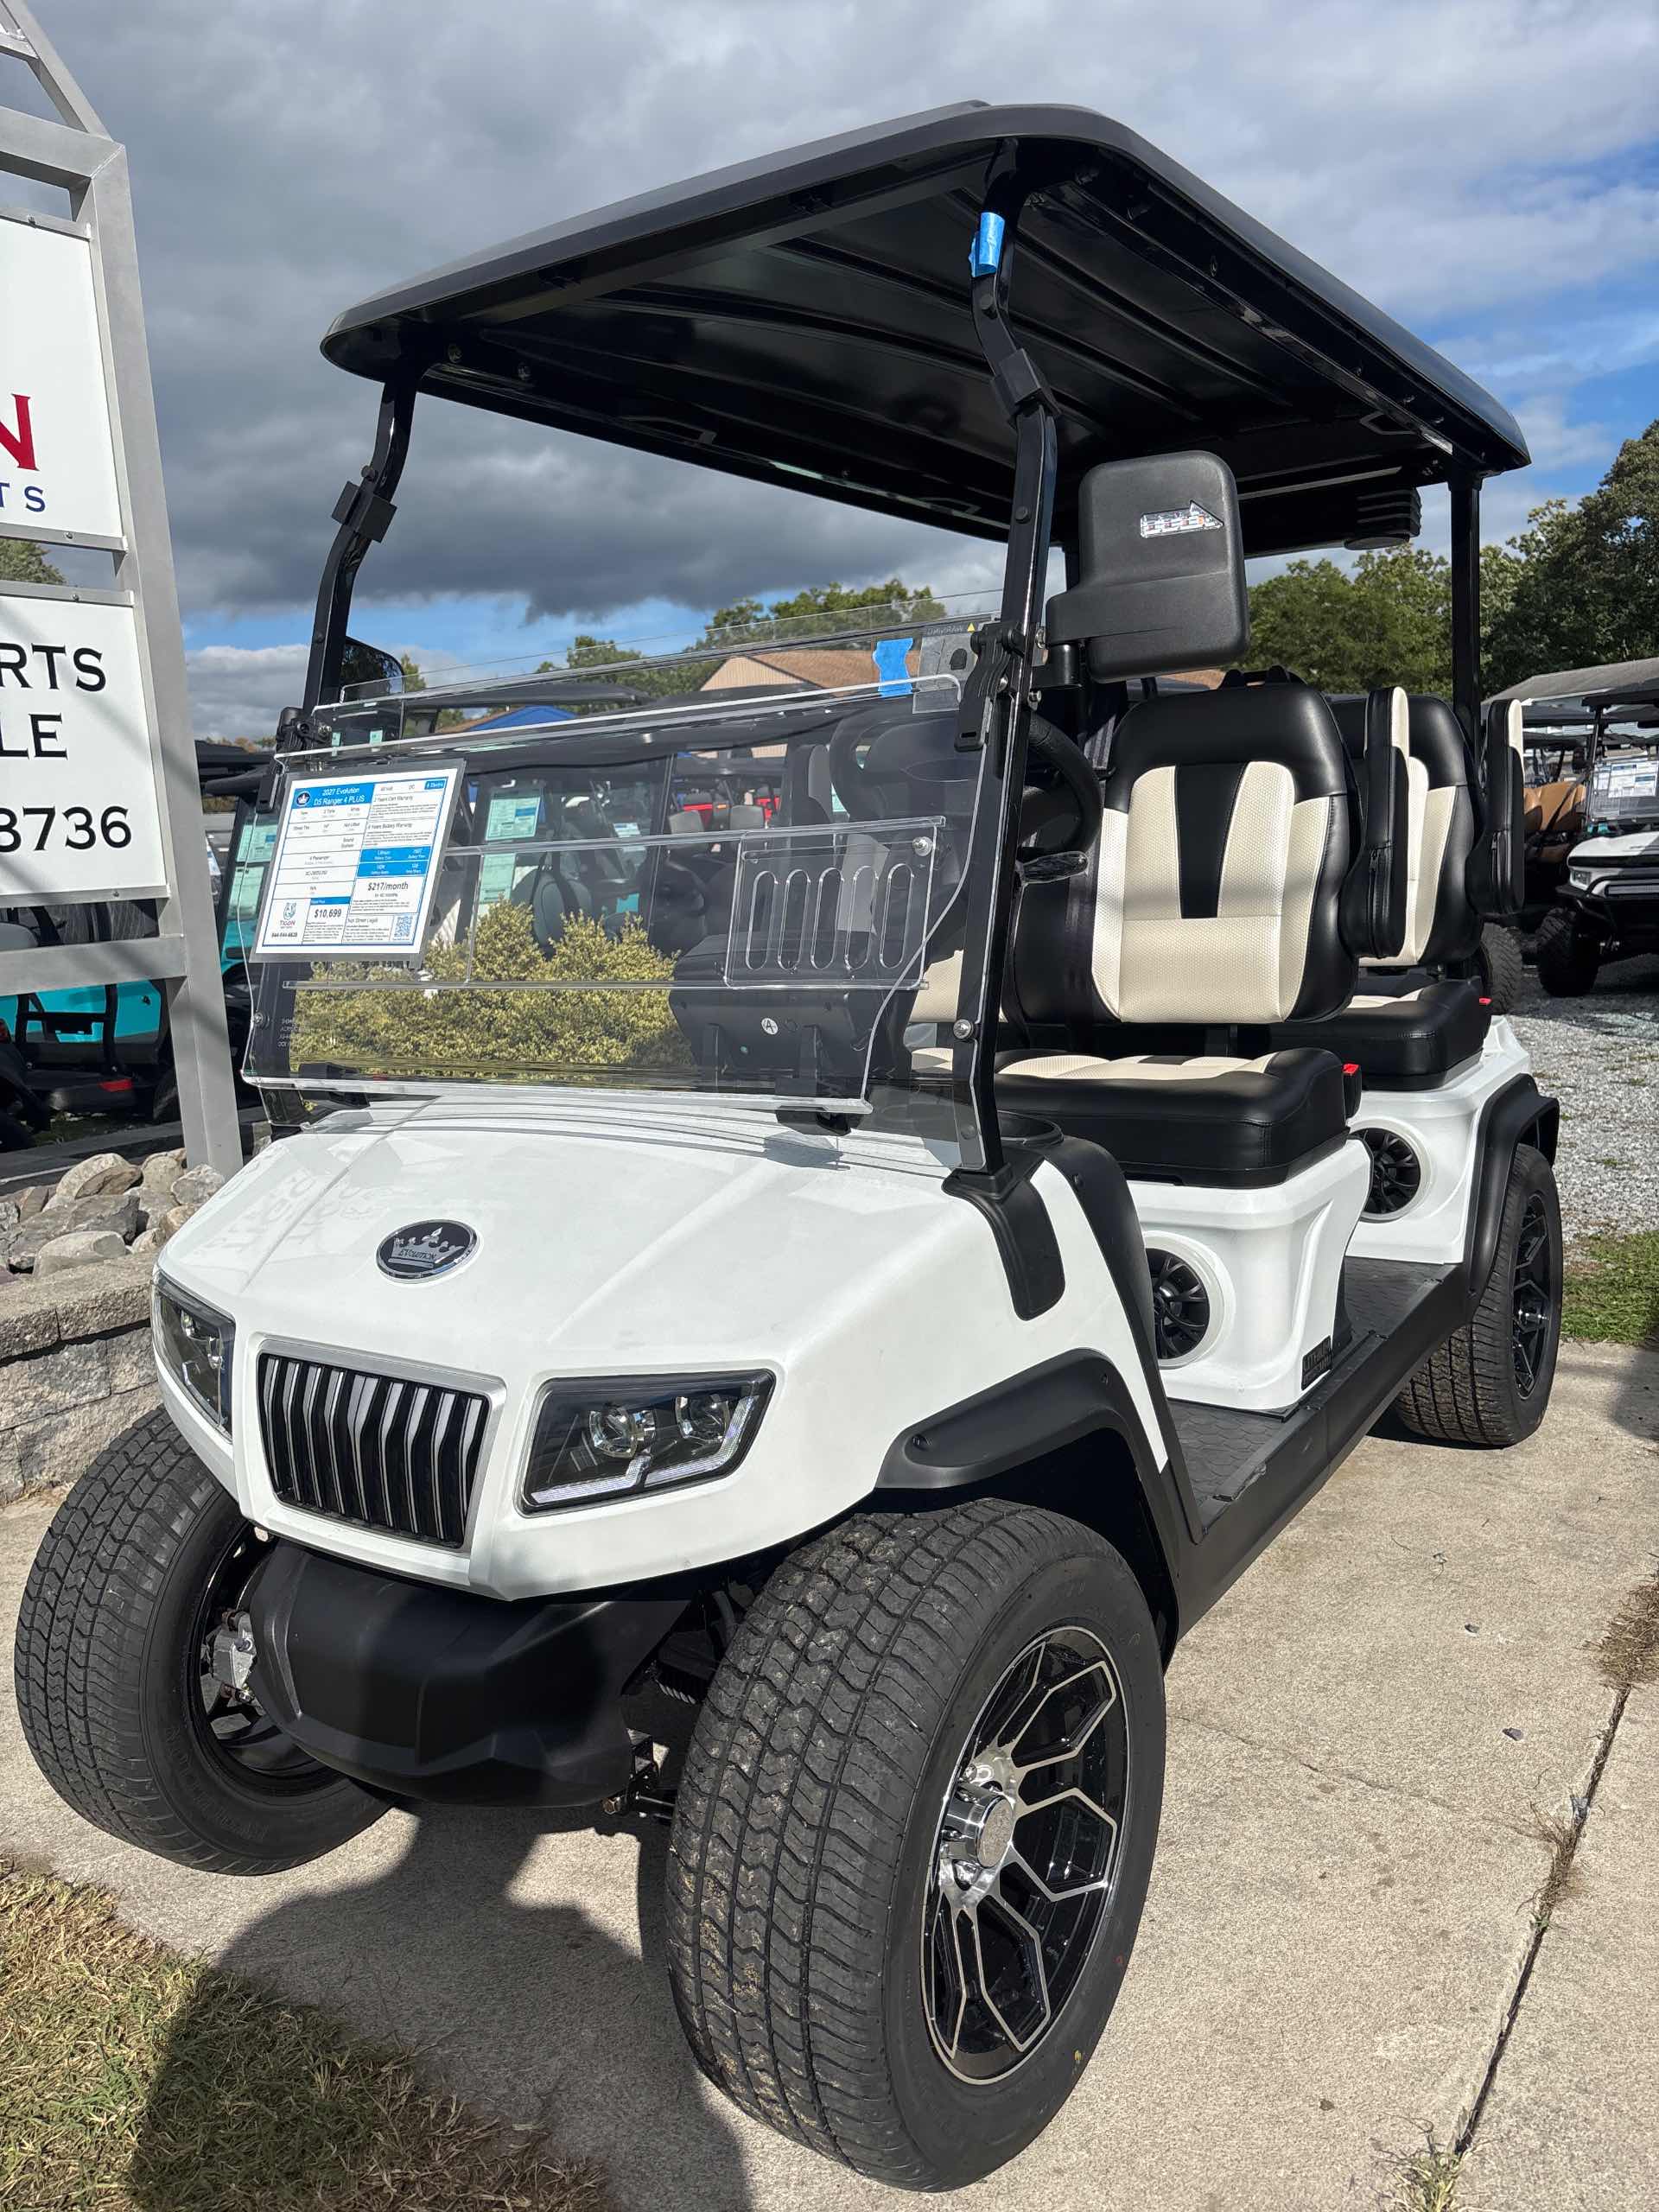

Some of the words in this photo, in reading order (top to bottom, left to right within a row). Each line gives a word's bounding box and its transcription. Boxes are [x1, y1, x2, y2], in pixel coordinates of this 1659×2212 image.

[0, 642, 106, 692] RTS
[348, 794, 365, 804] PLUS
[367, 880, 409, 892] $217/month
[314, 908, 342, 918] $10,699
